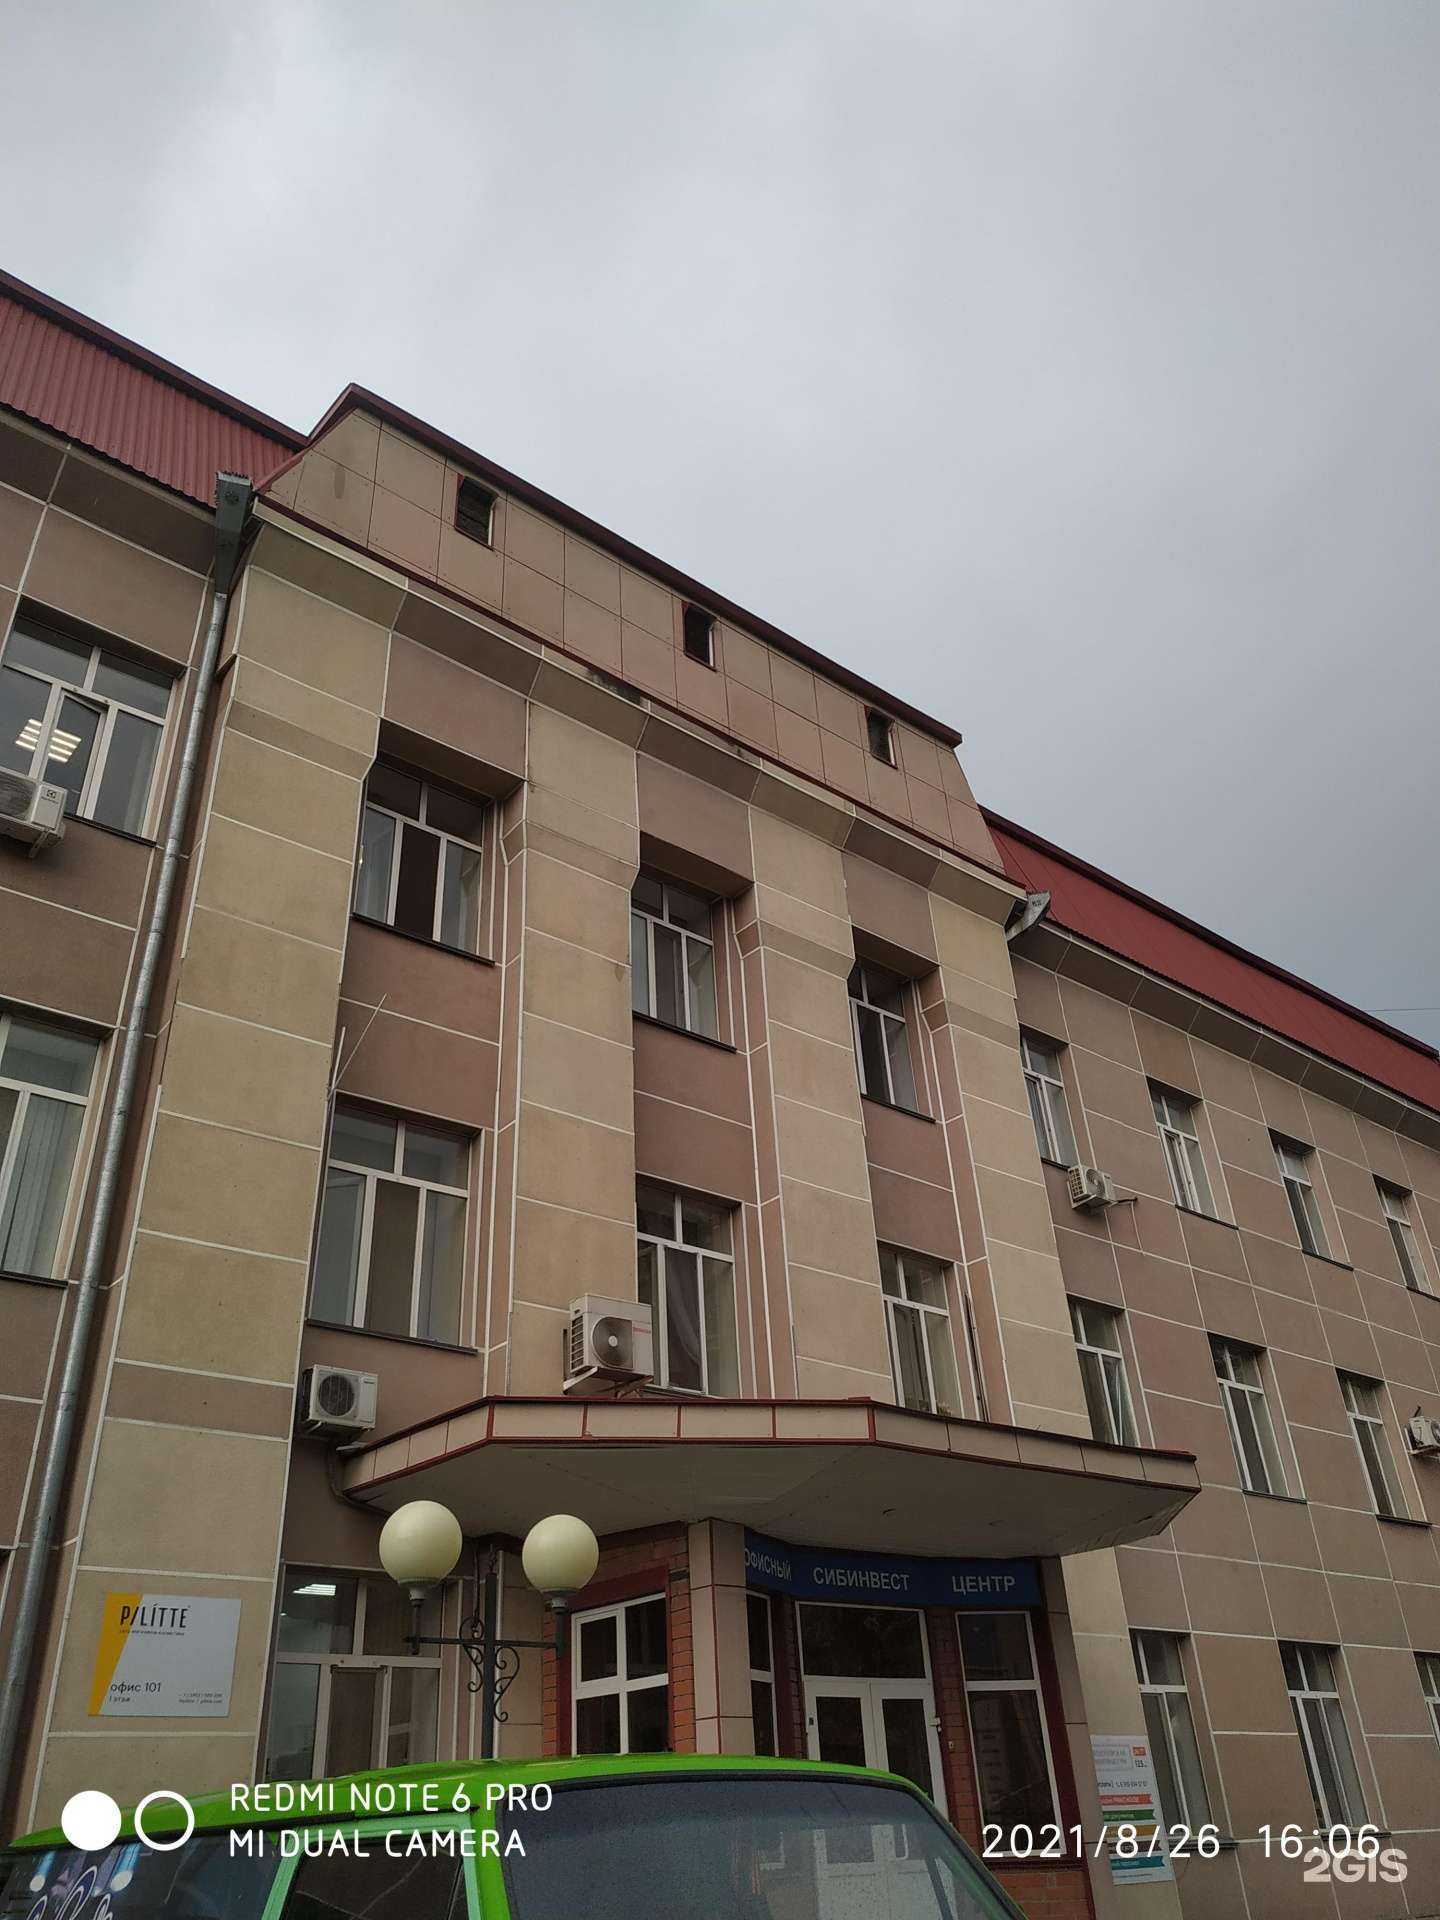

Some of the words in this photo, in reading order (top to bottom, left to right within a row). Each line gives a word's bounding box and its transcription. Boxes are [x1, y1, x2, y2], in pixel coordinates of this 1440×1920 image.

[812, 1567, 911, 1591] СИБИНВЕСТ
[951, 1575, 1016, 1596] ЦЕНТР
[110, 1680, 142, 1693] офис
[145, 1682, 162, 1693] 101
